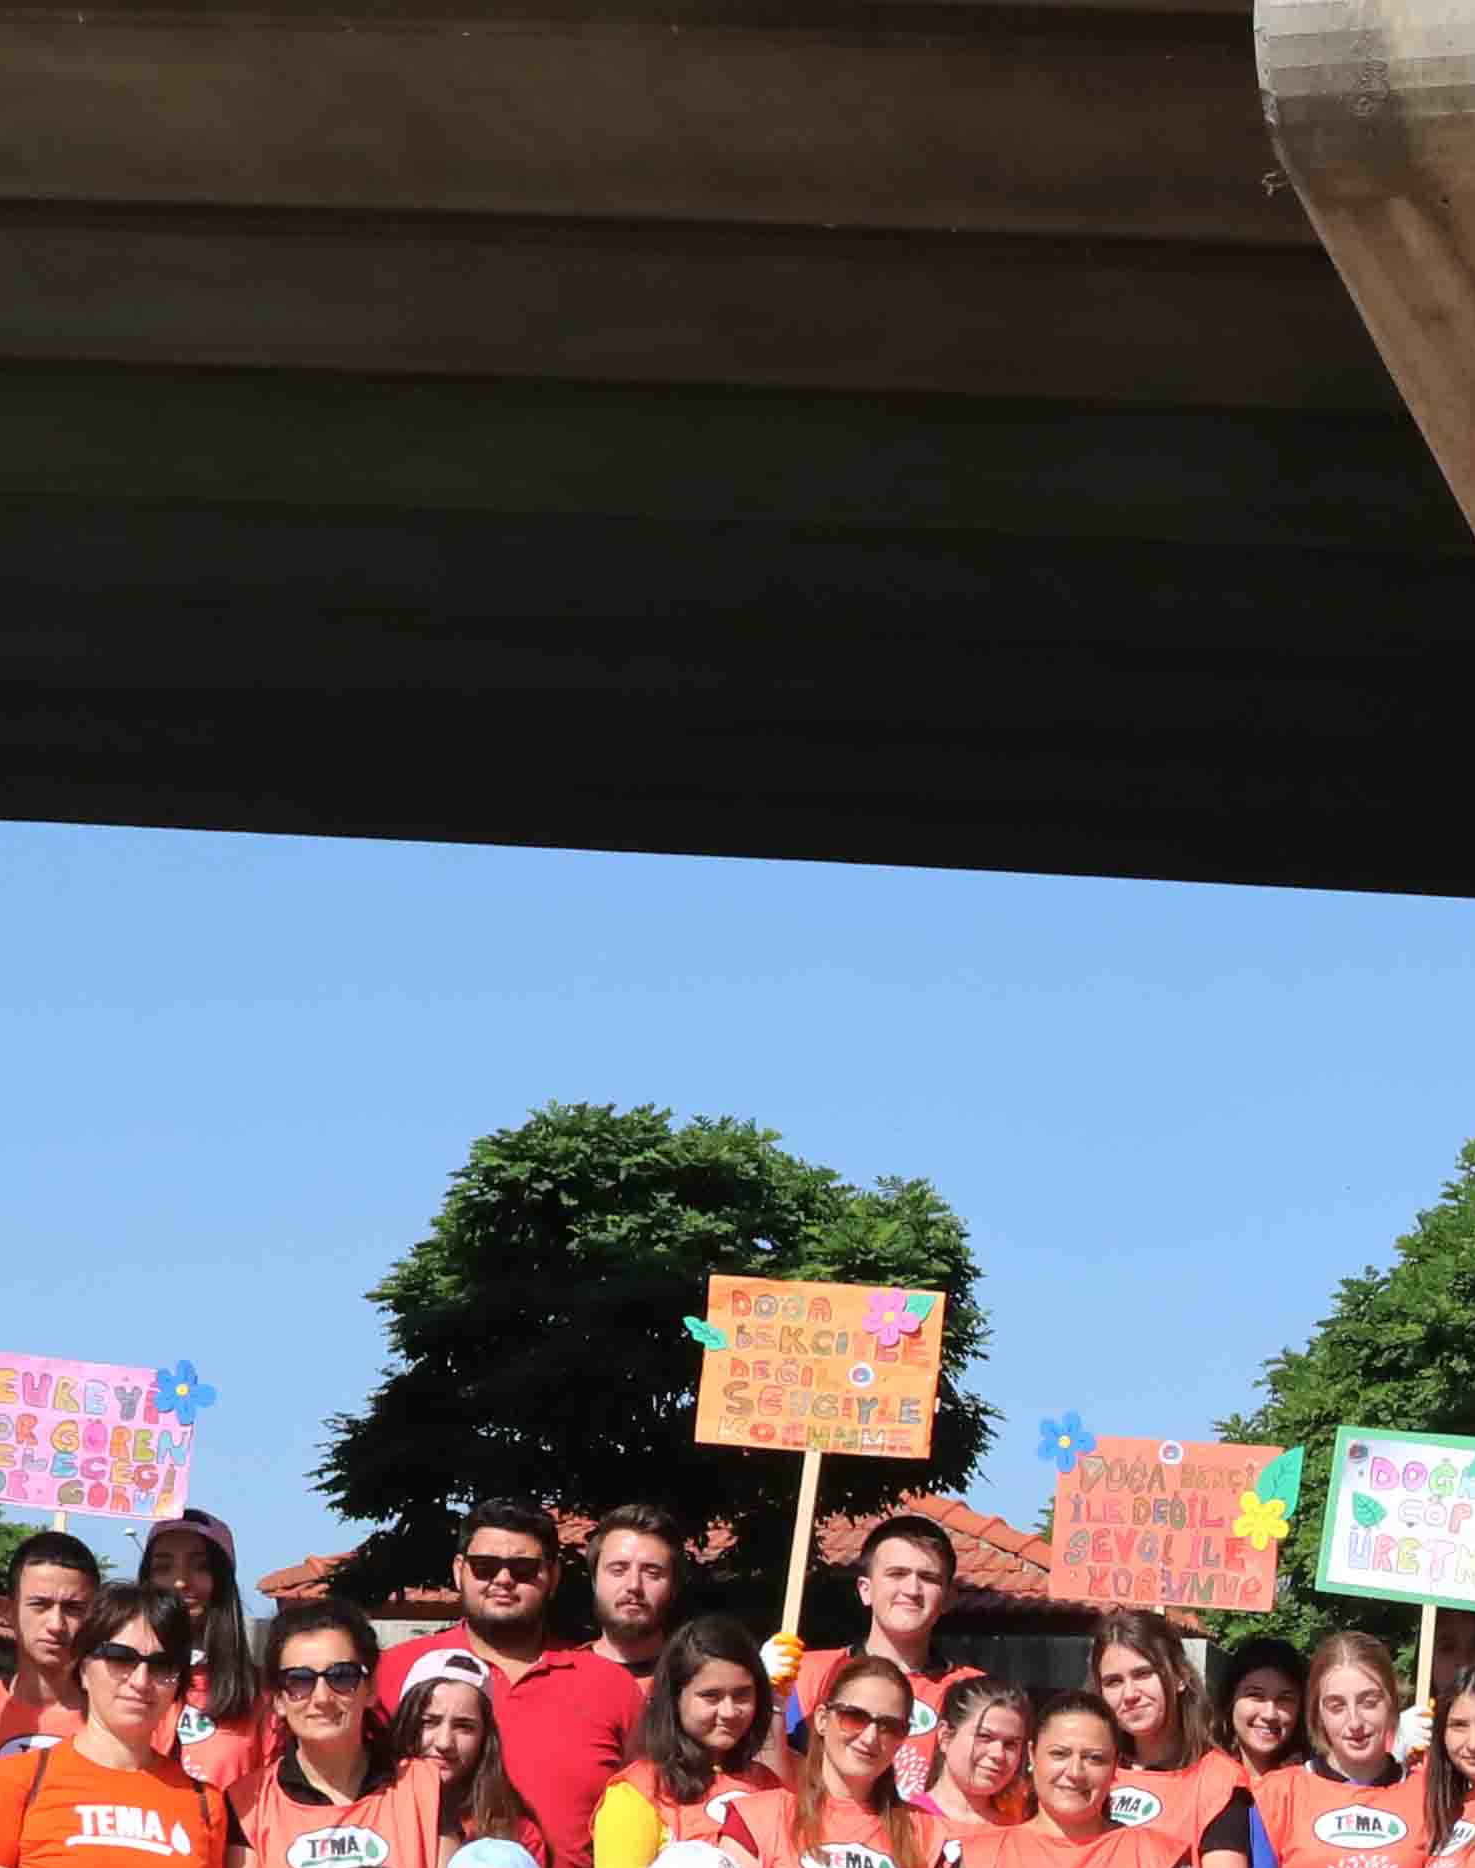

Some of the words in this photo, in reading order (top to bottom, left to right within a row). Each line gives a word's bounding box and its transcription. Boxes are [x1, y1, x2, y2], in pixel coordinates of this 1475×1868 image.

[75, 1805, 164, 1844] TEMA
[1334, 1815, 1383, 1832] TEMA
[308, 1836, 359, 1859] TEMA
